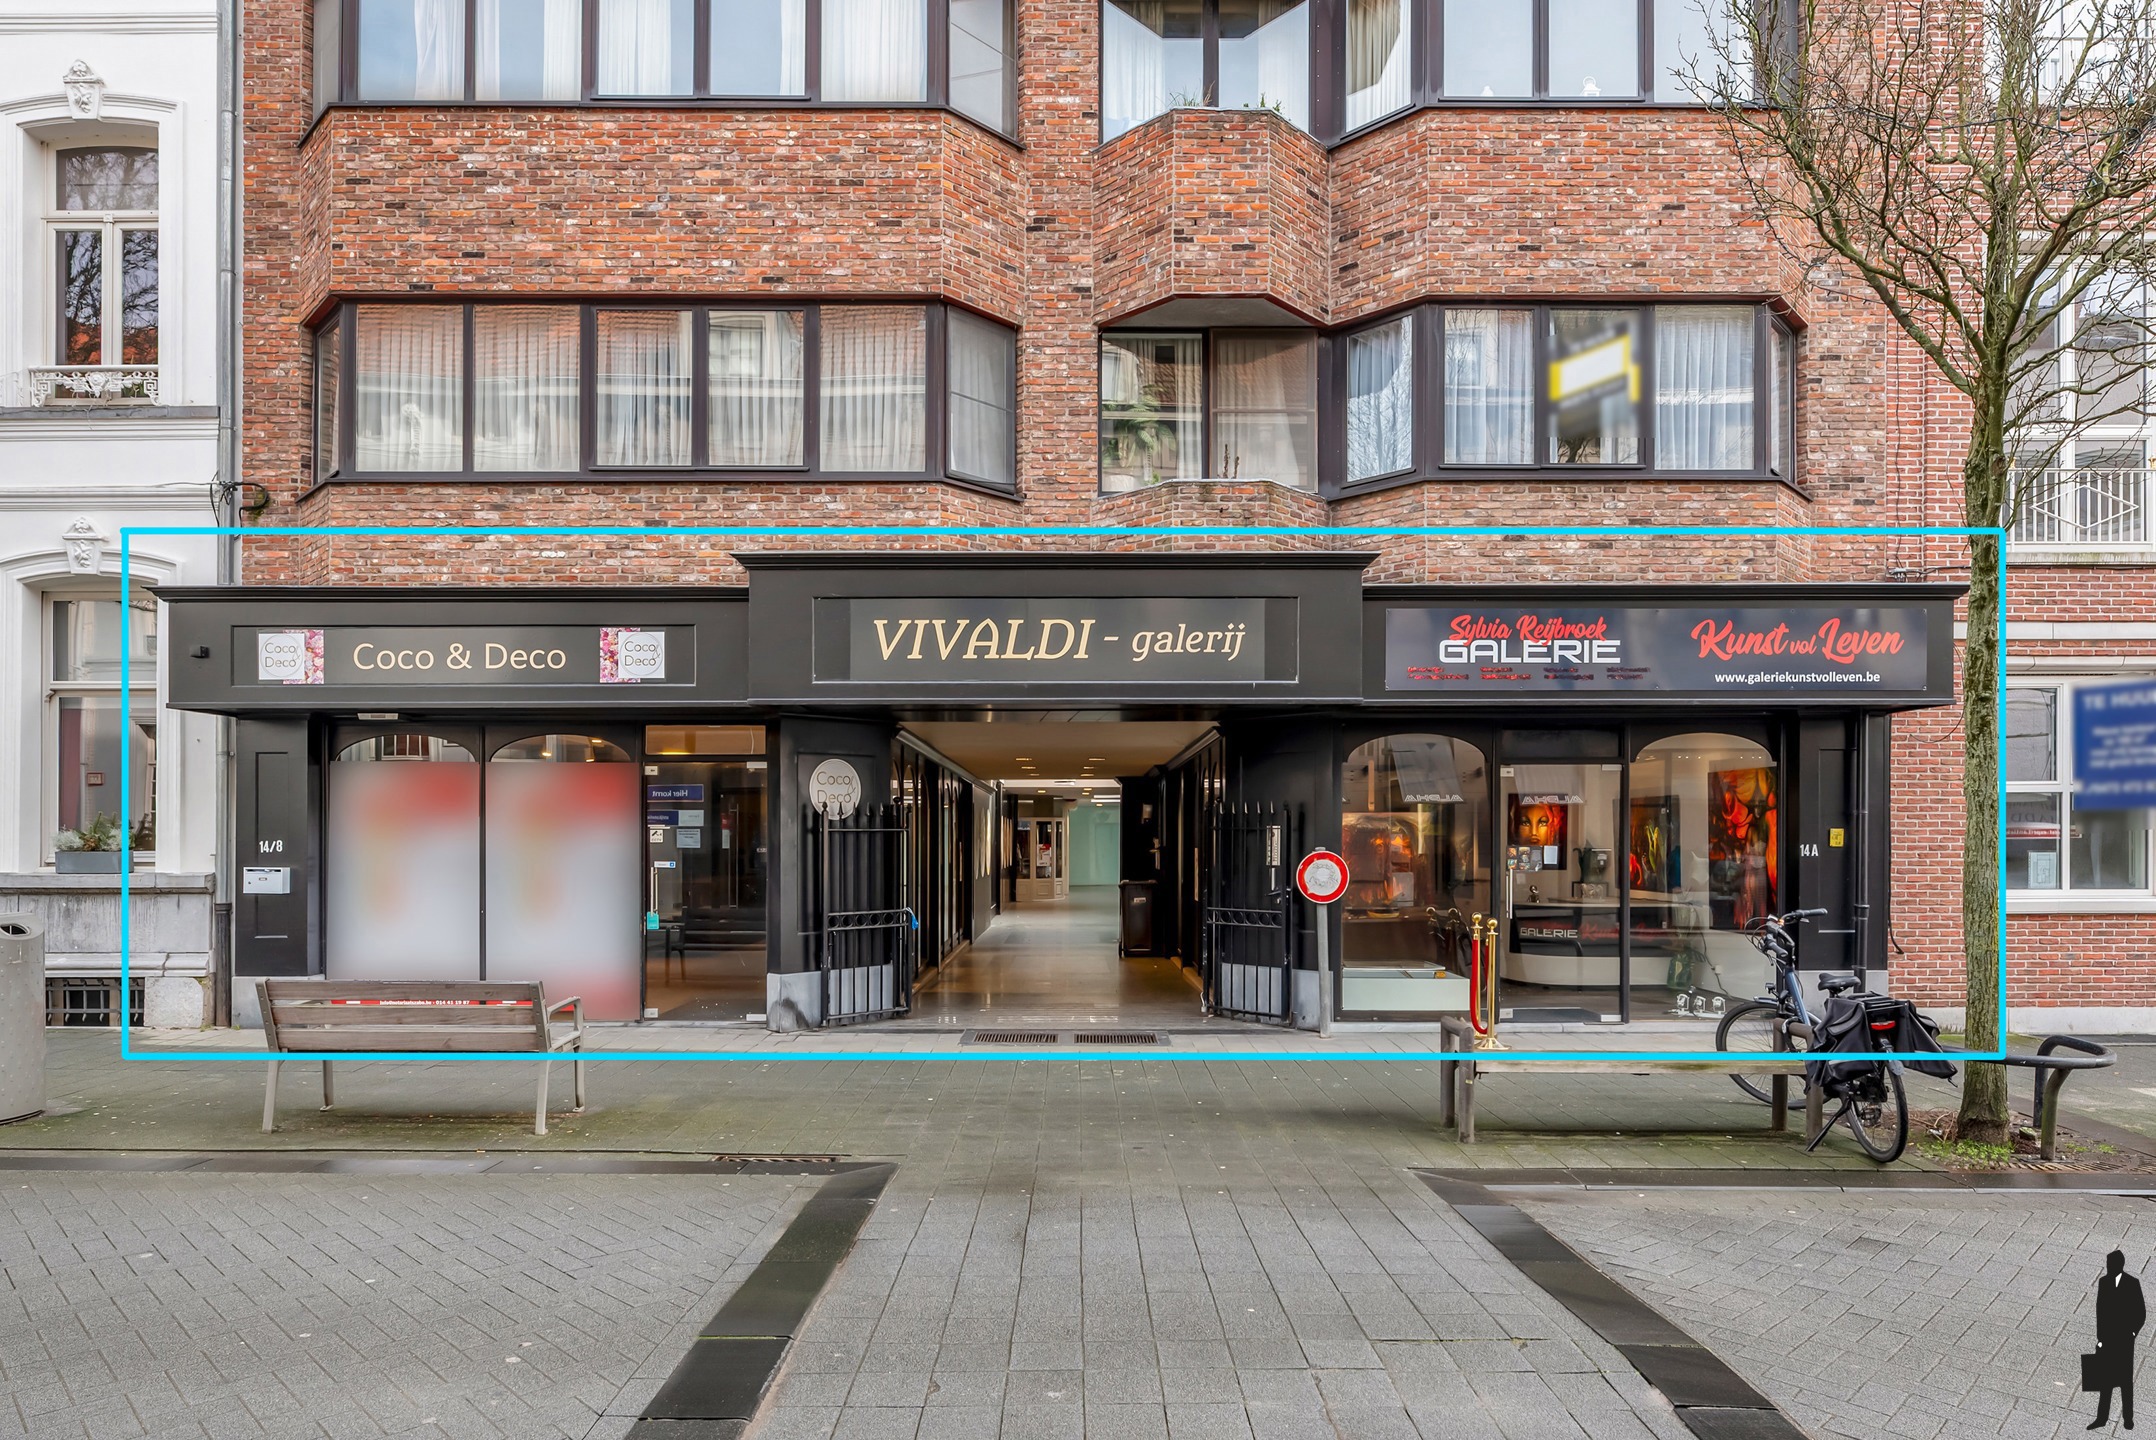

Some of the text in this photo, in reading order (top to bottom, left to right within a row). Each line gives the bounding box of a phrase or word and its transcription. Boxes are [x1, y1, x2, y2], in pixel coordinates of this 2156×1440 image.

[1449, 615, 1607, 646] Sylvia Reijbroek
[624, 641, 656, 652] Coco
[873, 618, 1096, 661] VIVALDI
[1131, 622, 1246, 662] galerij
[1690, 617, 1905, 664] Kunst vol Leven
[264, 642, 296, 654] Coco
[1439, 639, 1621, 664] GALERIE
[264, 656, 297, 668] Deco
[353, 643, 567, 670] Coco & Deco
[624, 655, 657, 666] Deco
[1715, 671, 1881, 684] www.galeriekunstvolleven.be
[816, 771, 851, 786] Coco
[817, 789, 852, 804] Deco
[259, 839, 283, 853] 14/8
[1520, 927, 1578, 939] GALERIE
